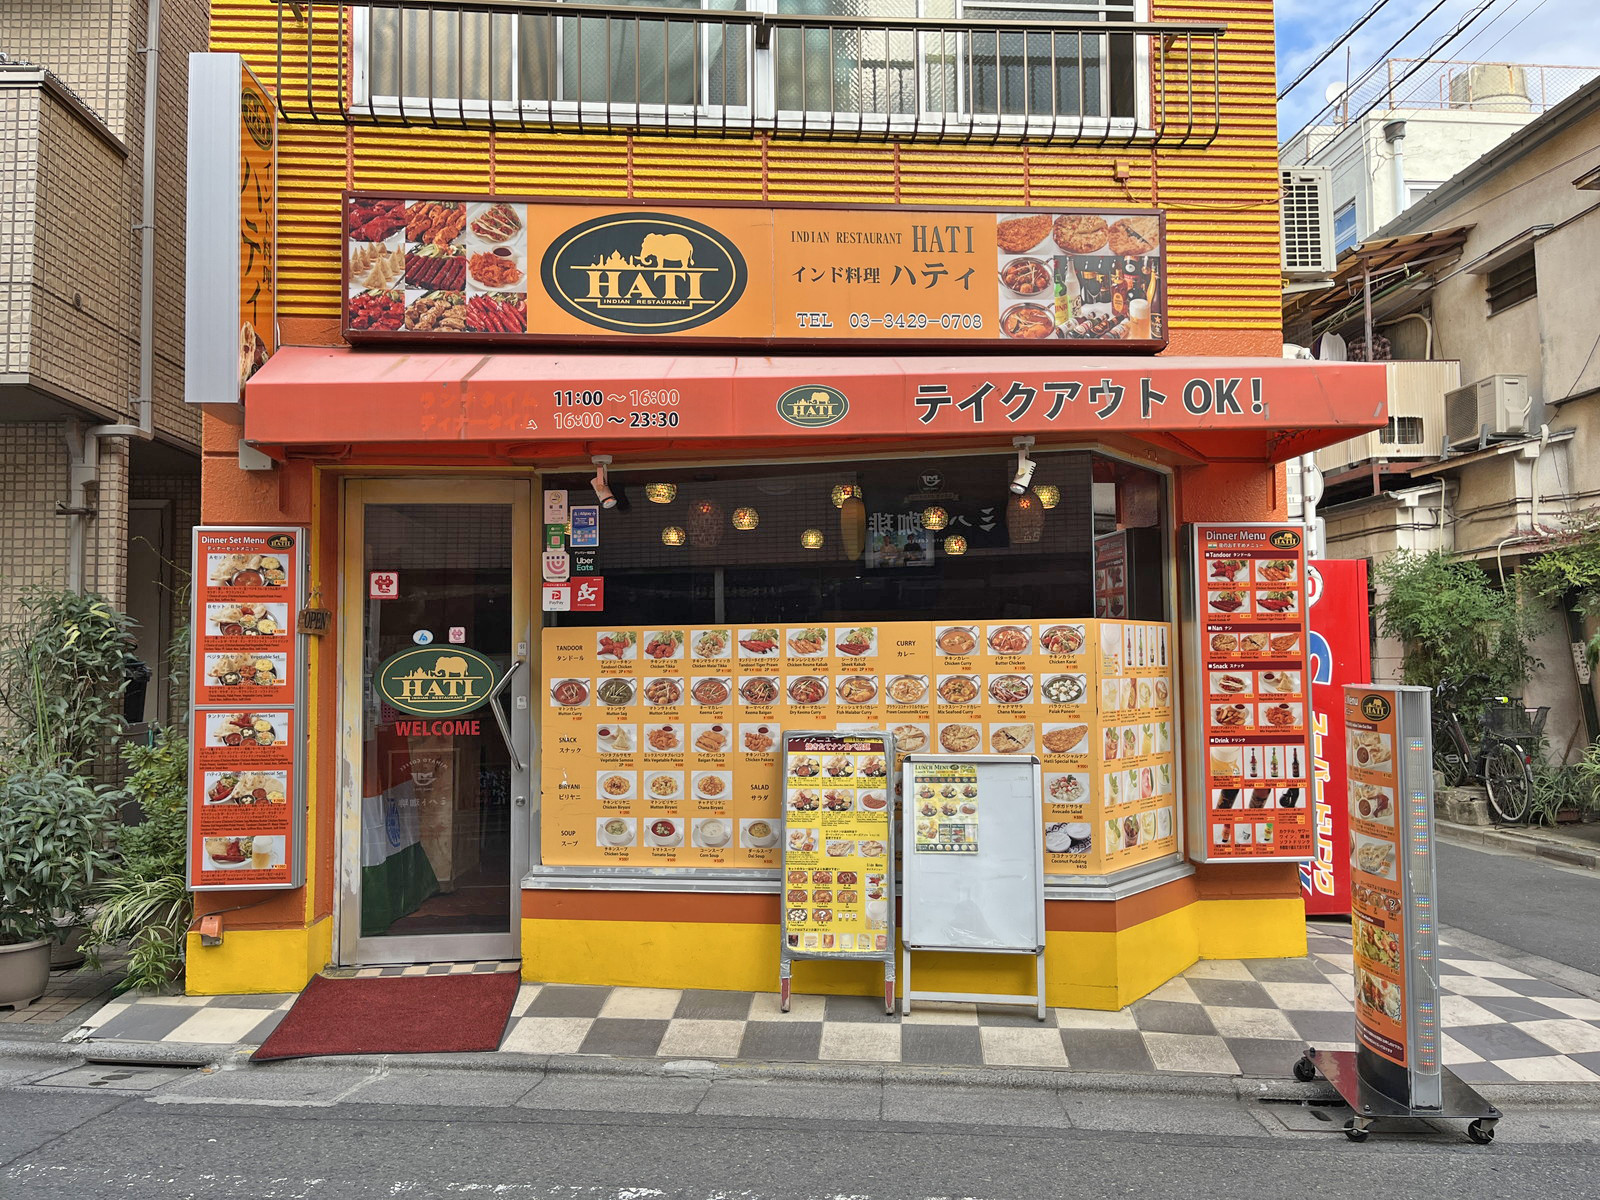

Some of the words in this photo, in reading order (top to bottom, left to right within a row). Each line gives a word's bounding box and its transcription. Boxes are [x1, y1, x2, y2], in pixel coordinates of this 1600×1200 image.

[791, 230, 831, 244] INDIAN
[836, 231, 902, 245] RESTAURANT
[911, 225, 975, 254] HATI
[585, 270, 706, 299] HATI
[791, 265, 880, 285] インド料理
[890, 262, 975, 291] ハティ
[795, 312, 833, 329] TEL
[848, 312, 982, 331] 03-3429-0708
[914, 376, 1168, 425] テイクアウト
[792, 404, 834, 417] HATI
[201, 536, 228, 544] Dinner
[229, 536, 242, 544] Set
[244, 536, 265, 544] Menu
[1206, 531, 1238, 540] Dinner
[1240, 531, 1266, 540] Menu
[304, 611, 328, 629] OPEN
[401, 679, 473, 696] HATI
[395, 720, 480, 736] WELCOME
